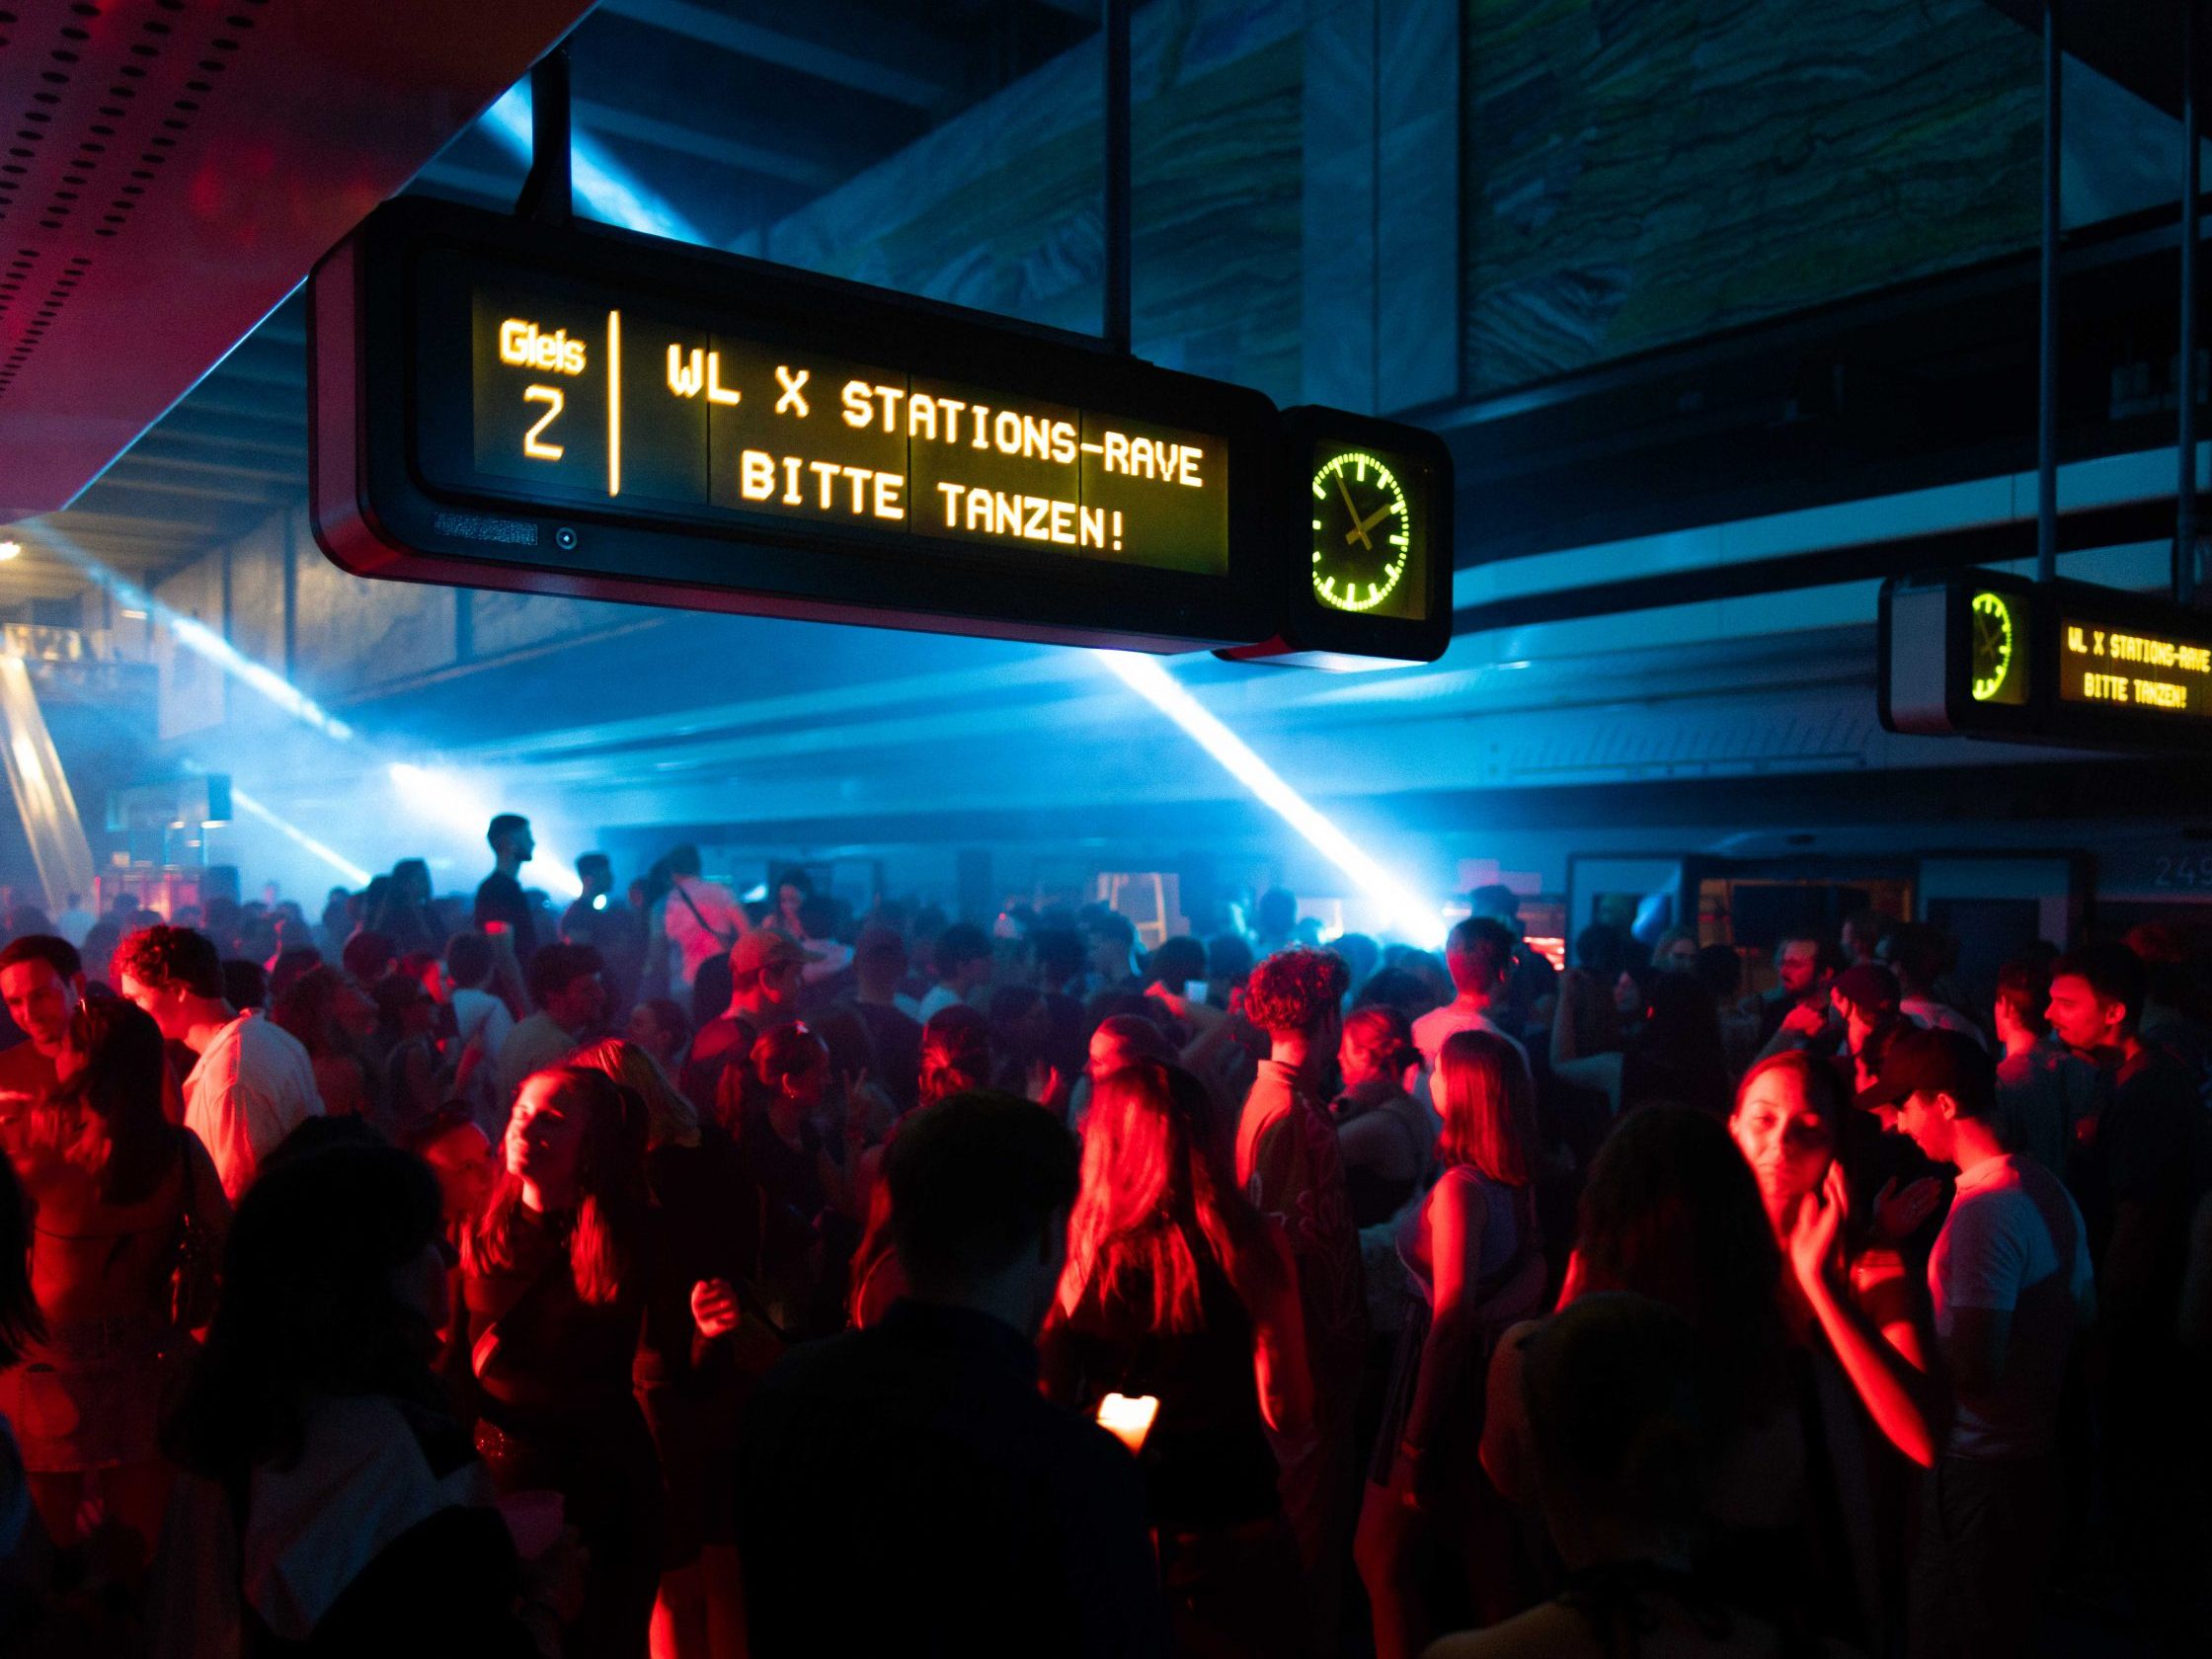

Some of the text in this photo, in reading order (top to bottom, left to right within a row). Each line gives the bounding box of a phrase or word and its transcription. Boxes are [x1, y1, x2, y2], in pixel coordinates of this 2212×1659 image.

[500, 318, 587, 375] Gleis
[523, 384, 564, 460] 2
[667, 344, 1203, 488] WL X STATIONS-RAVE
[741, 449, 1123, 551] BITTE TANZEN!
[2094, 630, 2104, 656] X
[2084, 672, 2187, 709] BITTE TANZEN!
